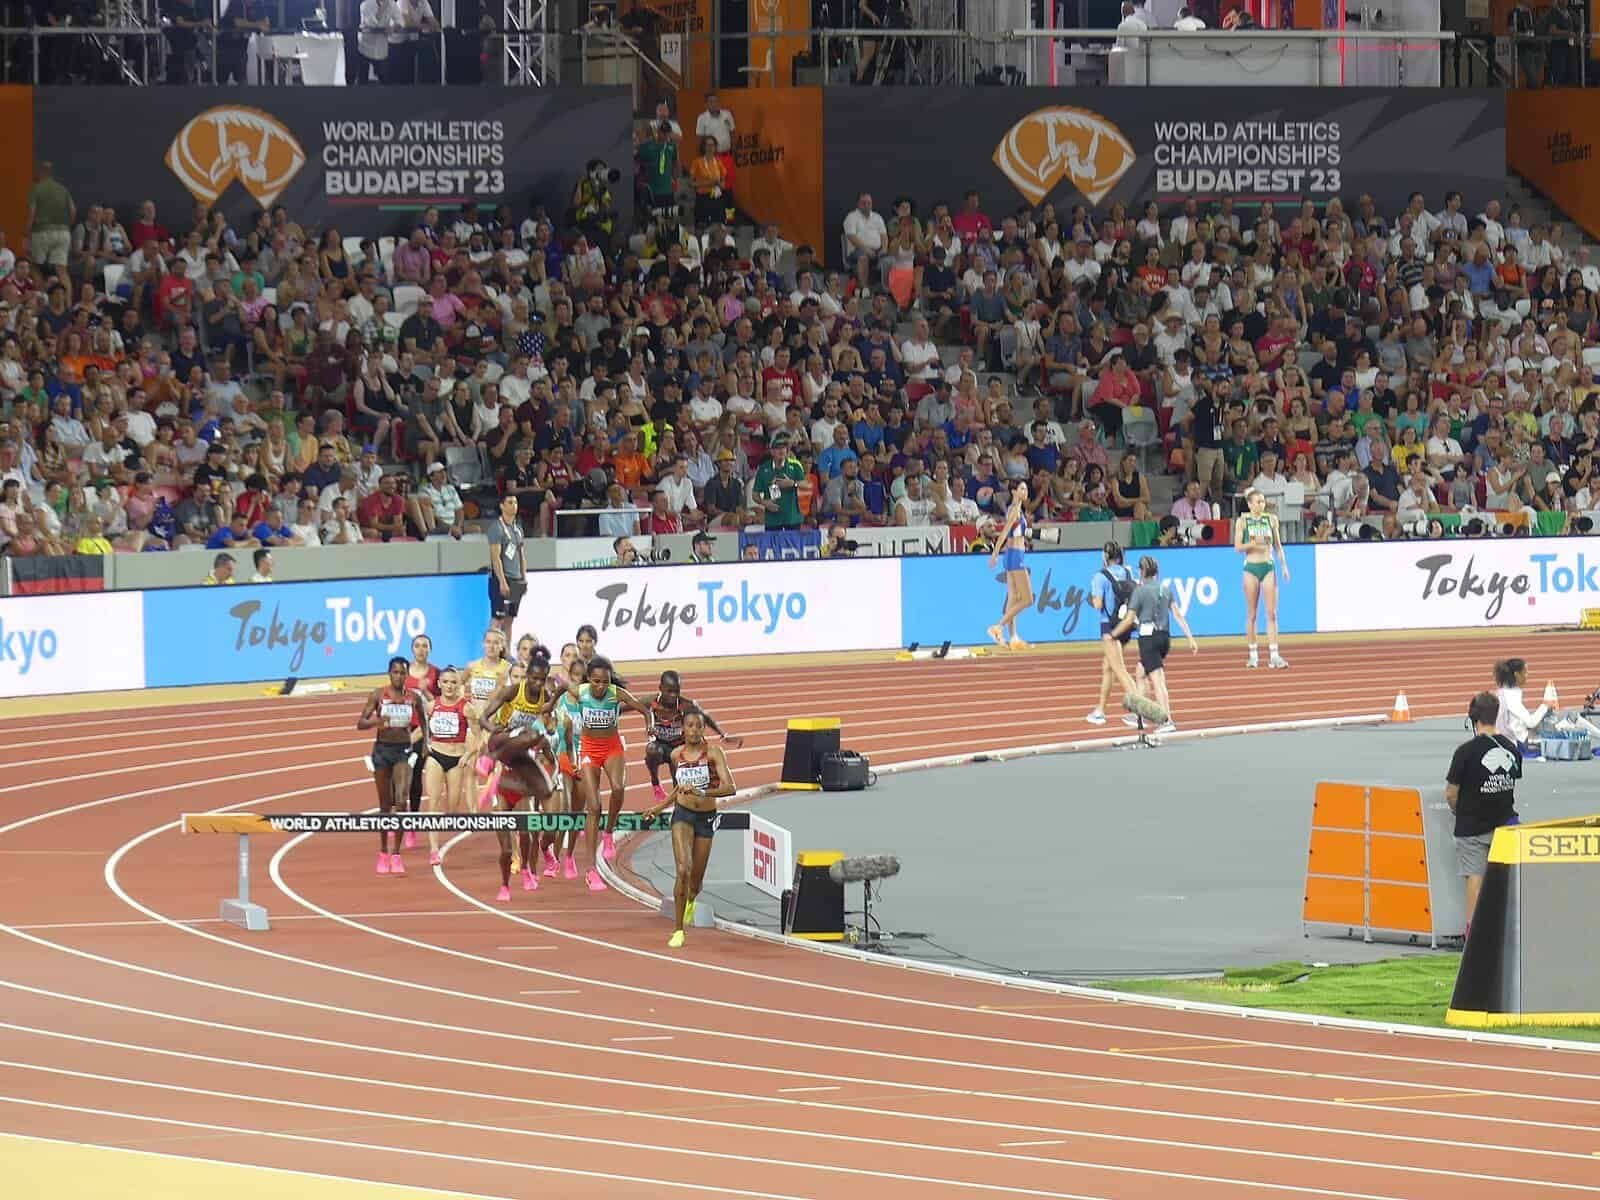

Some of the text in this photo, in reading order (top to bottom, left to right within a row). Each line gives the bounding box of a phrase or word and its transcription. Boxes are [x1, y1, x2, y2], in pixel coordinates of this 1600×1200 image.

[322, 121, 504, 141] WORLD ATHLETICS
[1154, 121, 1341, 141] WORLD ATHLETICS
[323, 143, 504, 166] CHAMPIONSHIPS
[1154, 143, 1341, 165] CHAMPIONSHIPS
[325, 169, 505, 194] BUDAPEST 23
[1156, 168, 1341, 192] BUDAPEST 23
[1416, 553, 1530, 620] Tokyo
[596, 580, 807, 652] Tokyo Tokyo
[230, 597, 427, 672] Tokyo Tokyo
[681, 768, 703, 777] NTN
[271, 816, 322, 830] WORLD
[325, 816, 399, 830] ATHLETICS
[401, 815, 517, 830] CHAMPIONSHIPS
[527, 813, 644, 831] BUDAST
